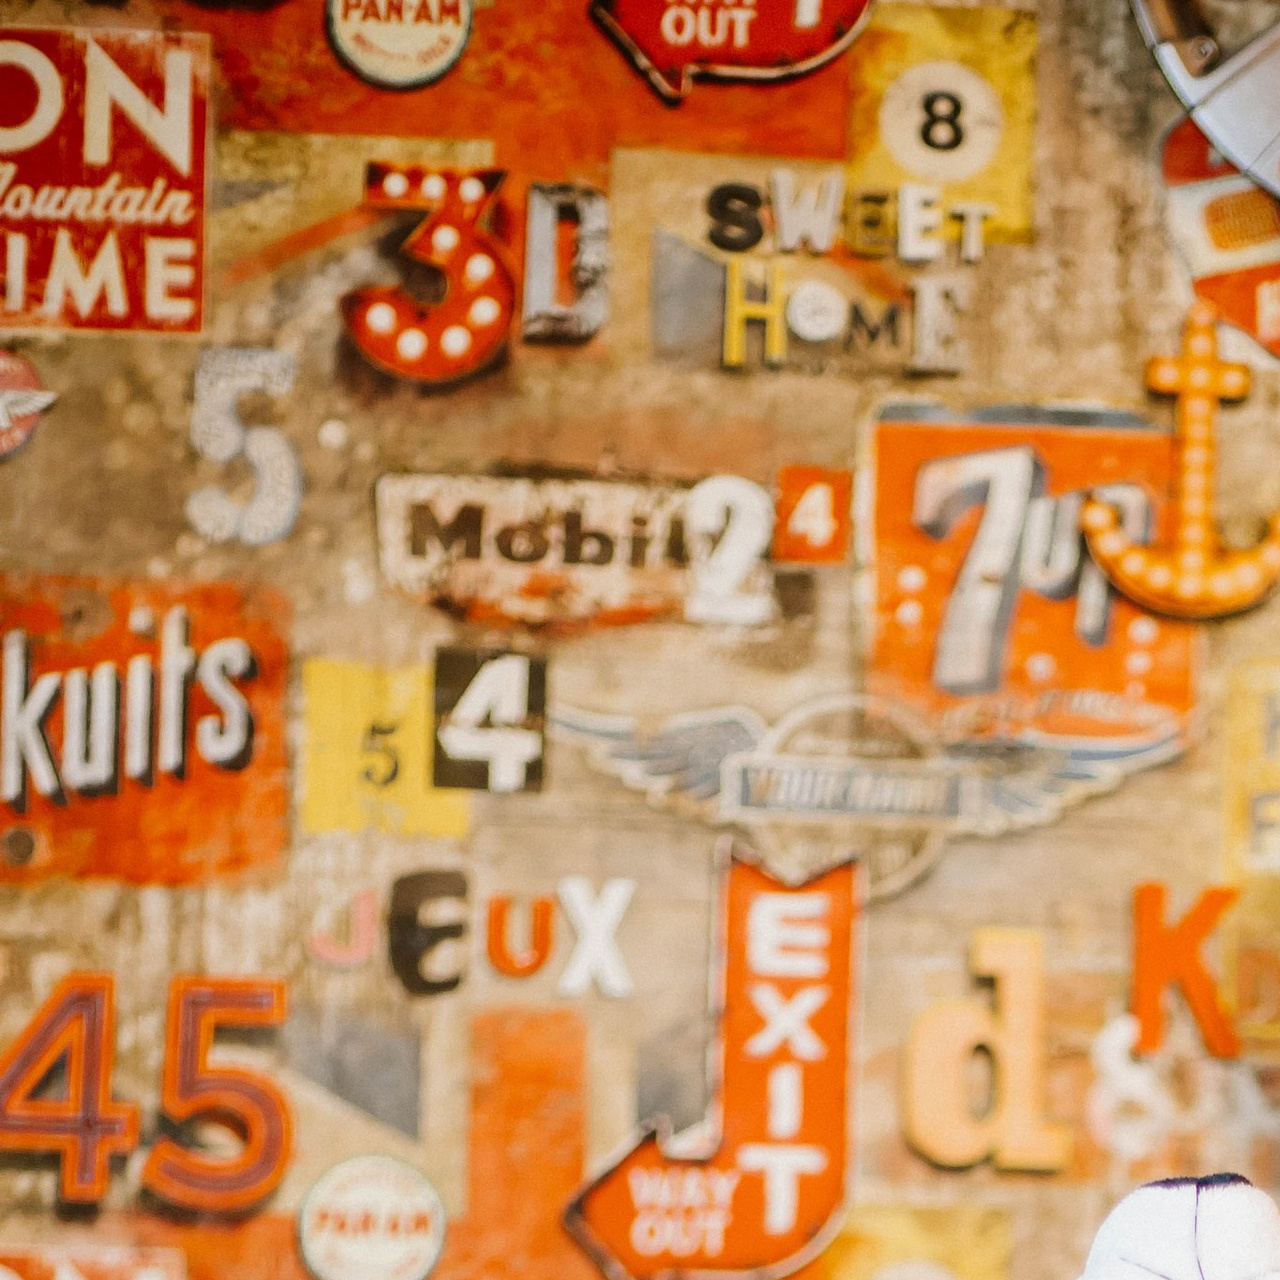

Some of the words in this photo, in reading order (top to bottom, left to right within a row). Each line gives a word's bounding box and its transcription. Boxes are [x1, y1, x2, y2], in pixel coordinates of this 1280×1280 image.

[661, 6, 757, 47] OUT
[919, 92, 965, 151] 8
[185, 347, 303, 547] 5
[683, 474, 778, 626] 2
[438, 655, 542, 792] 4
[1130, 878, 1242, 1060] K
[740, 890, 832, 1237] EXIT
[629, 1211, 731, 1258] OUT
